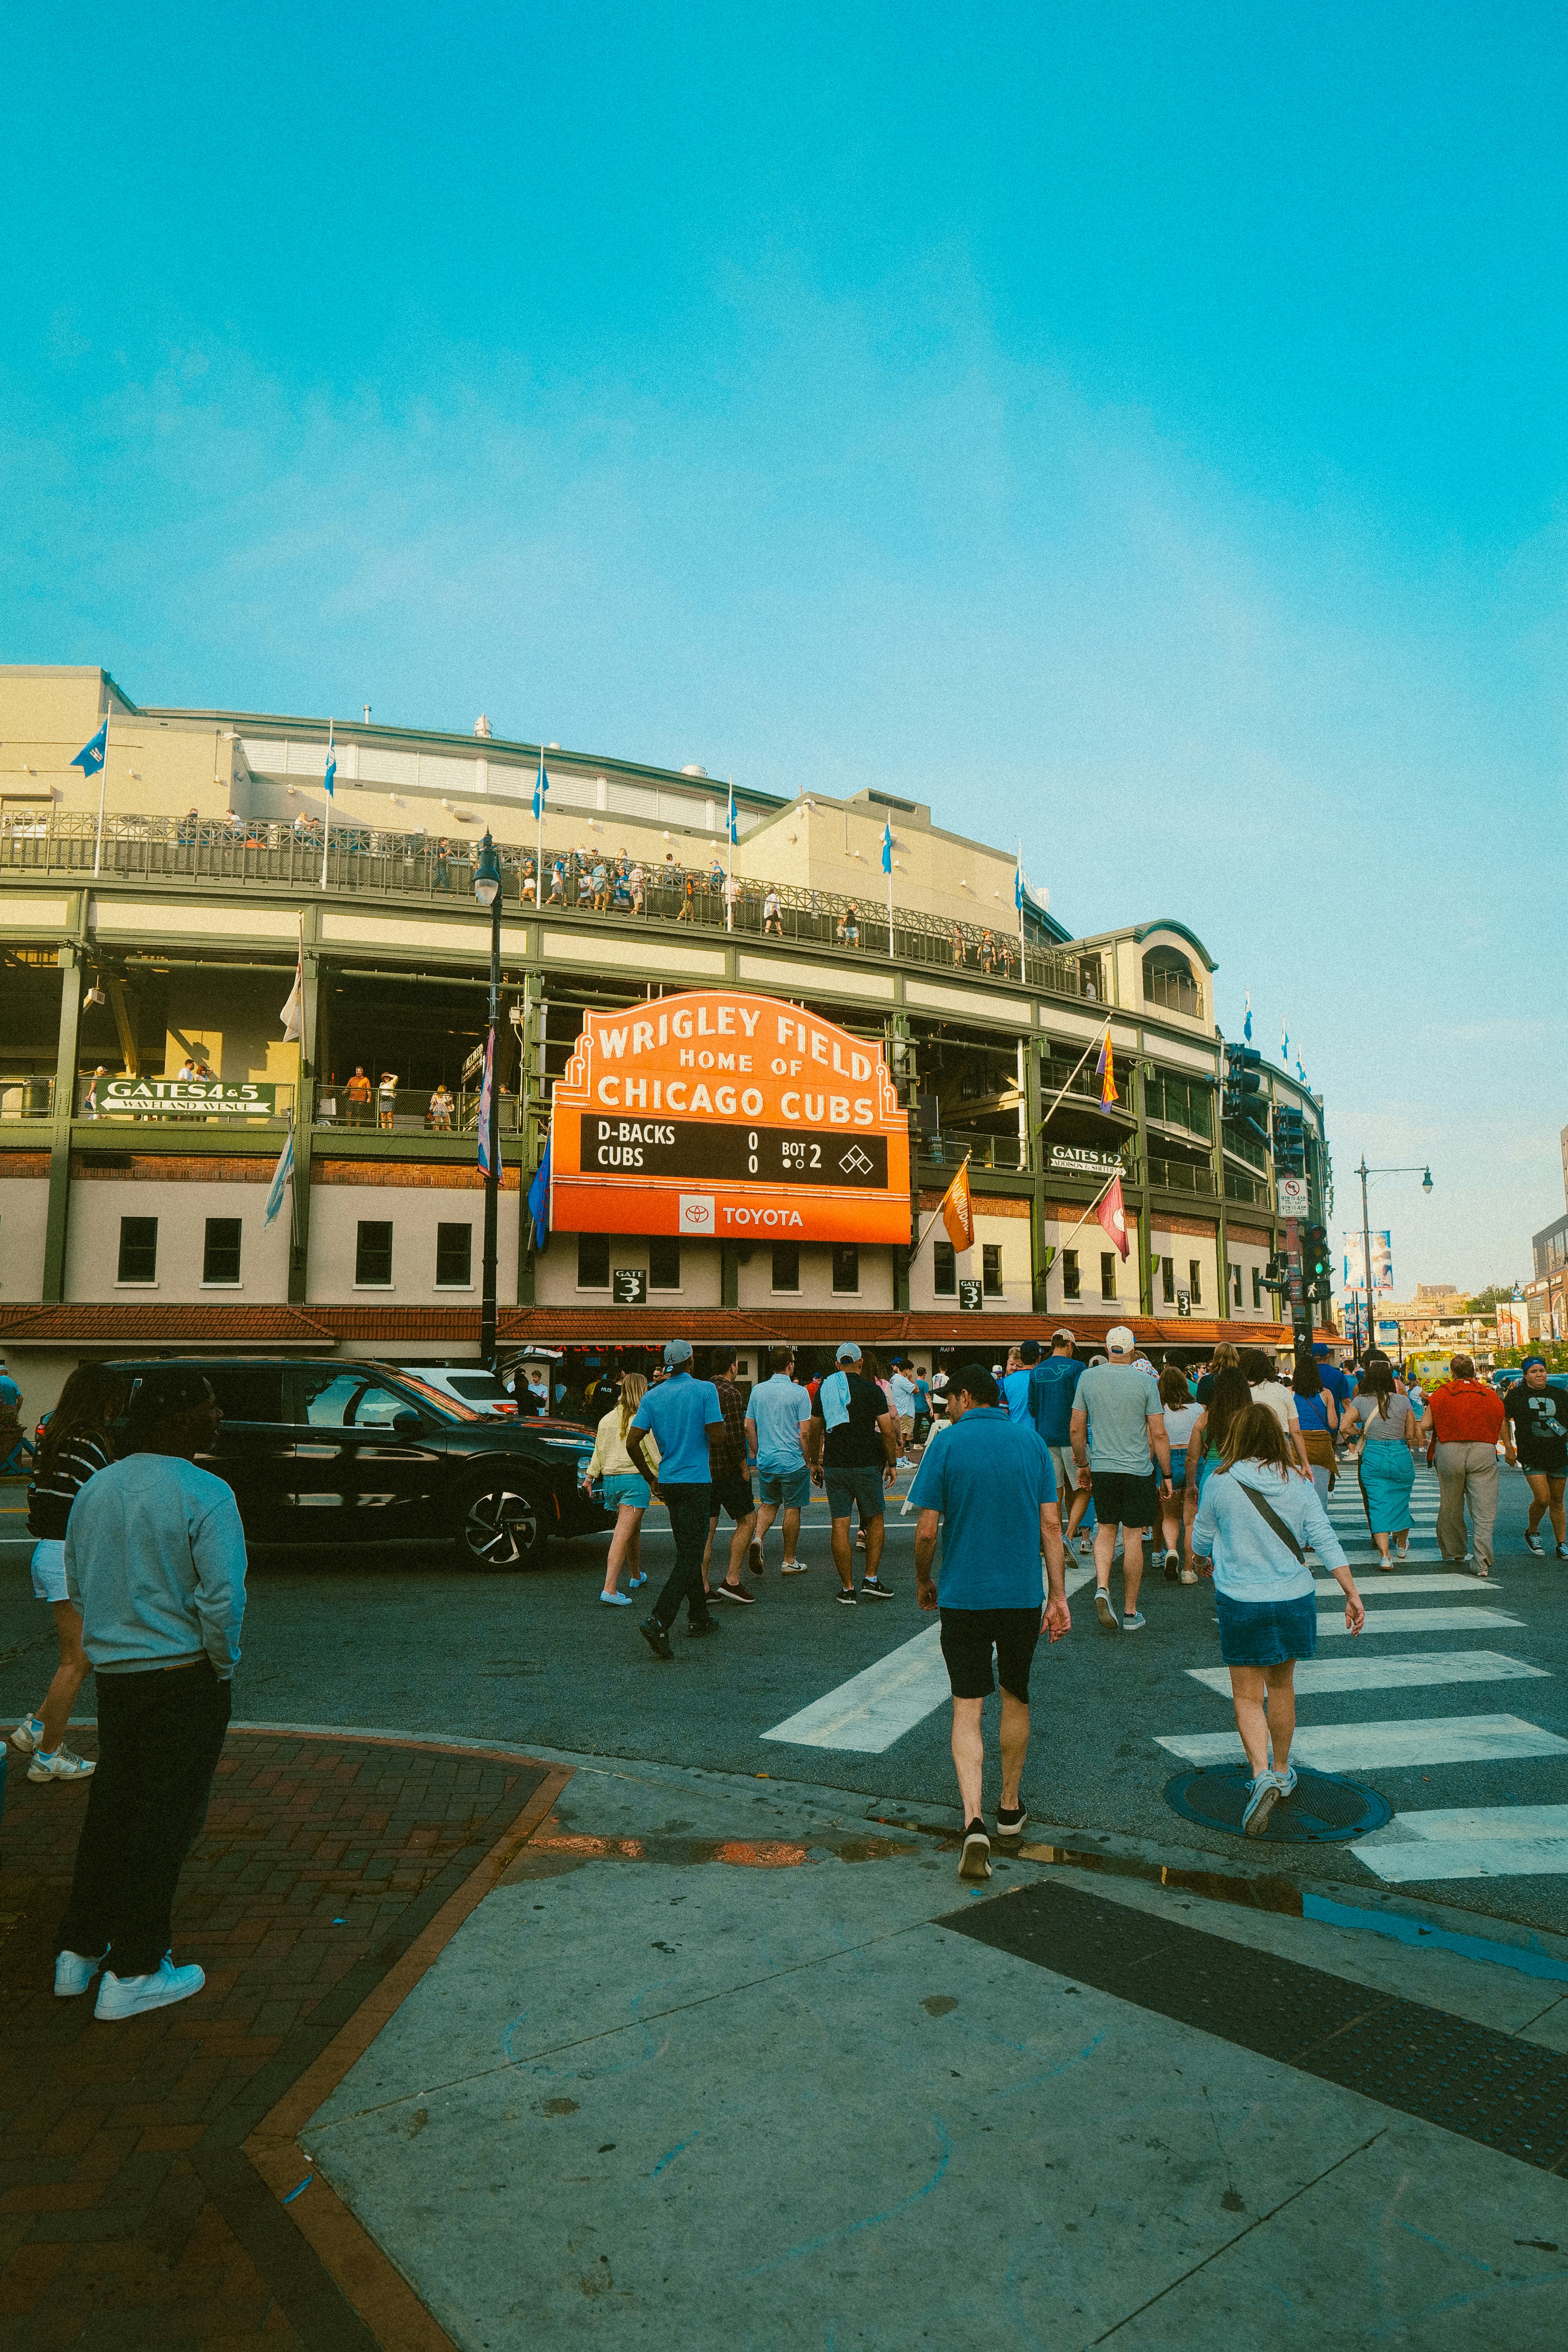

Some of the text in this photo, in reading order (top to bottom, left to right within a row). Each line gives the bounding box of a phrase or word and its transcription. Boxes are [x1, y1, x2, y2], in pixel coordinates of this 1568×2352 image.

[599, 1006, 872, 1082] WRIGLEY FIELD
[680, 1049, 803, 1076] HOME OF
[107, 1082, 206, 1099] GATES
[123, 1100, 252, 1111] WAVELAND AVENUE
[598, 1076, 875, 1126] CHICAGO CUBS
[598, 1121, 758, 1150] D-BACKS 0
[598, 1145, 758, 1173] CUBS 0
[782, 1142, 822, 1168] BOT 2
[1053, 1146, 1098, 1163] GATES
[1053, 1159, 1083, 1169] ADDISON
[1092, 1165, 1123, 1174] SHEFFIED
[722, 1207, 803, 1227] TOYOTA
[619, 1278, 640, 1296] 3
[964, 1287, 978, 1303] 3
[1180, 1296, 1189, 1310] 3
[1528, 1397, 1556, 1437] 3
